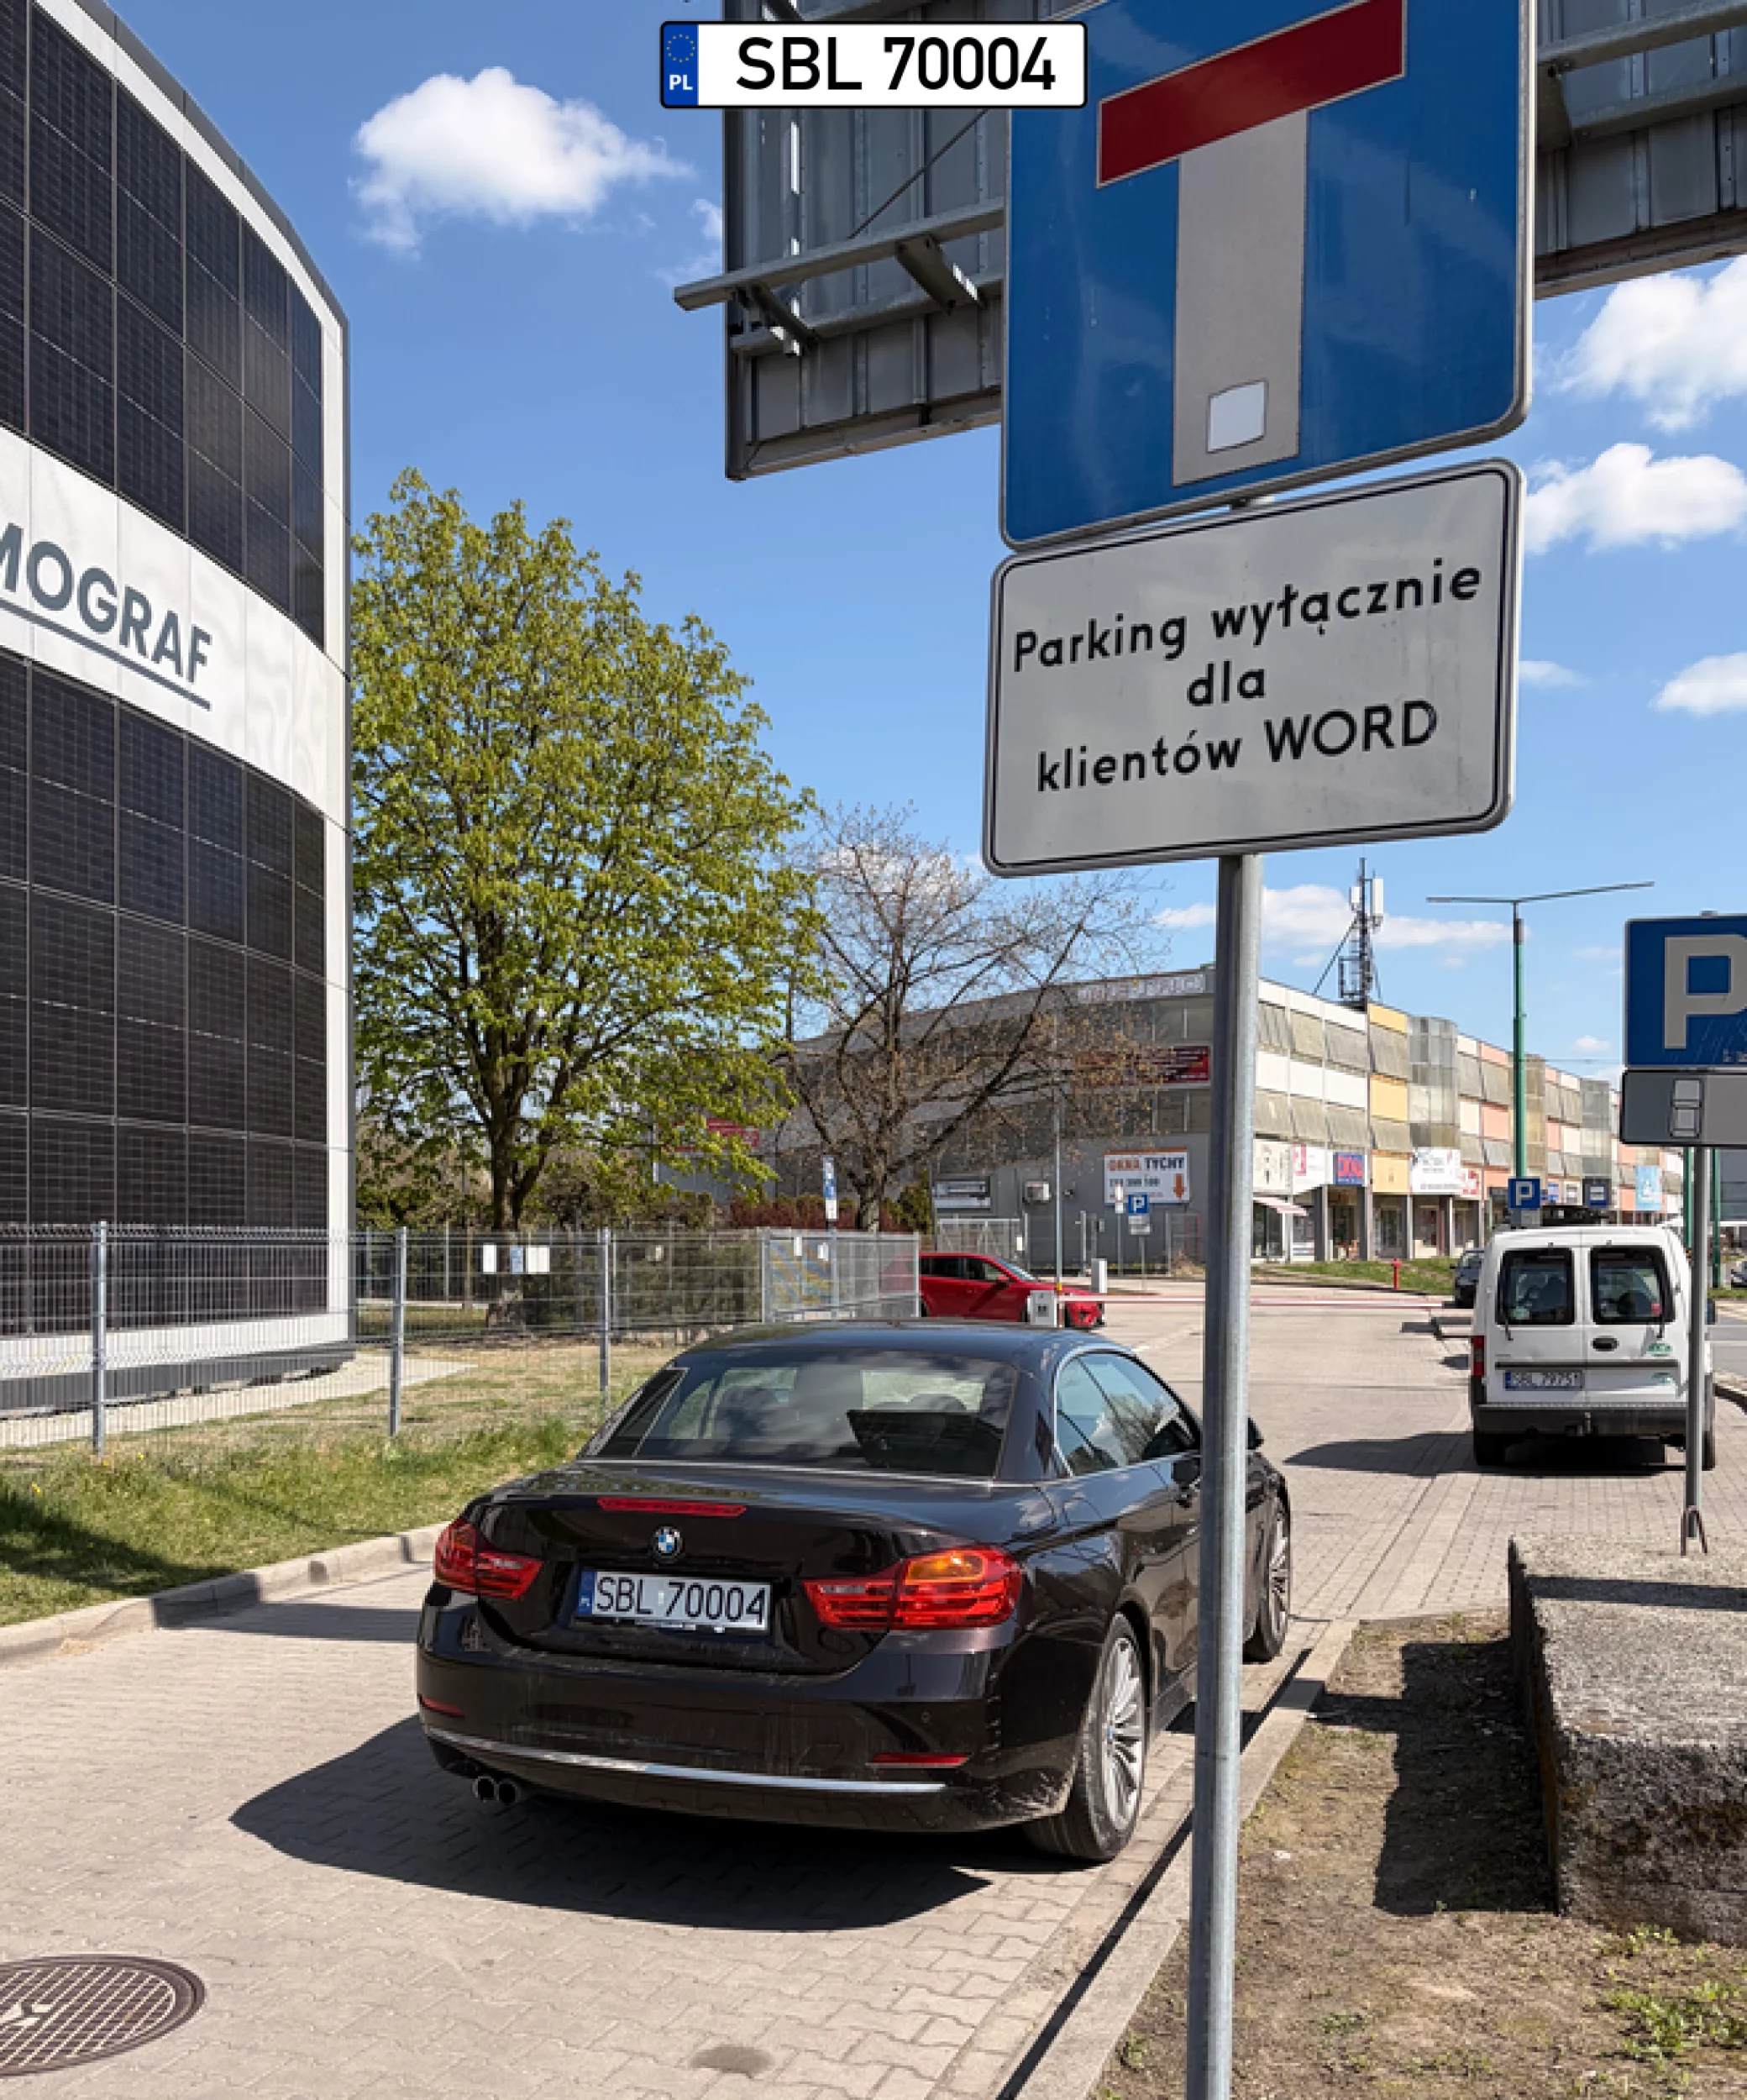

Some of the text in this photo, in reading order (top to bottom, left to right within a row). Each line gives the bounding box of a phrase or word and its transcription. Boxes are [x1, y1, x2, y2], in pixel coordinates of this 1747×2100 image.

[1014, 557, 1482, 673] Parking wyłącznie
[1186, 660, 1266, 707] dla
[1037, 700, 1438, 792] klientów WORD
[1664, 934, 1747, 1049] P
[1144, 1156, 1185, 1171] TYCHY
[1133, 1197, 1145, 1211] P
[1515, 1181, 1533, 1206] P
[596, 1576, 766, 1625] SBL 70004
